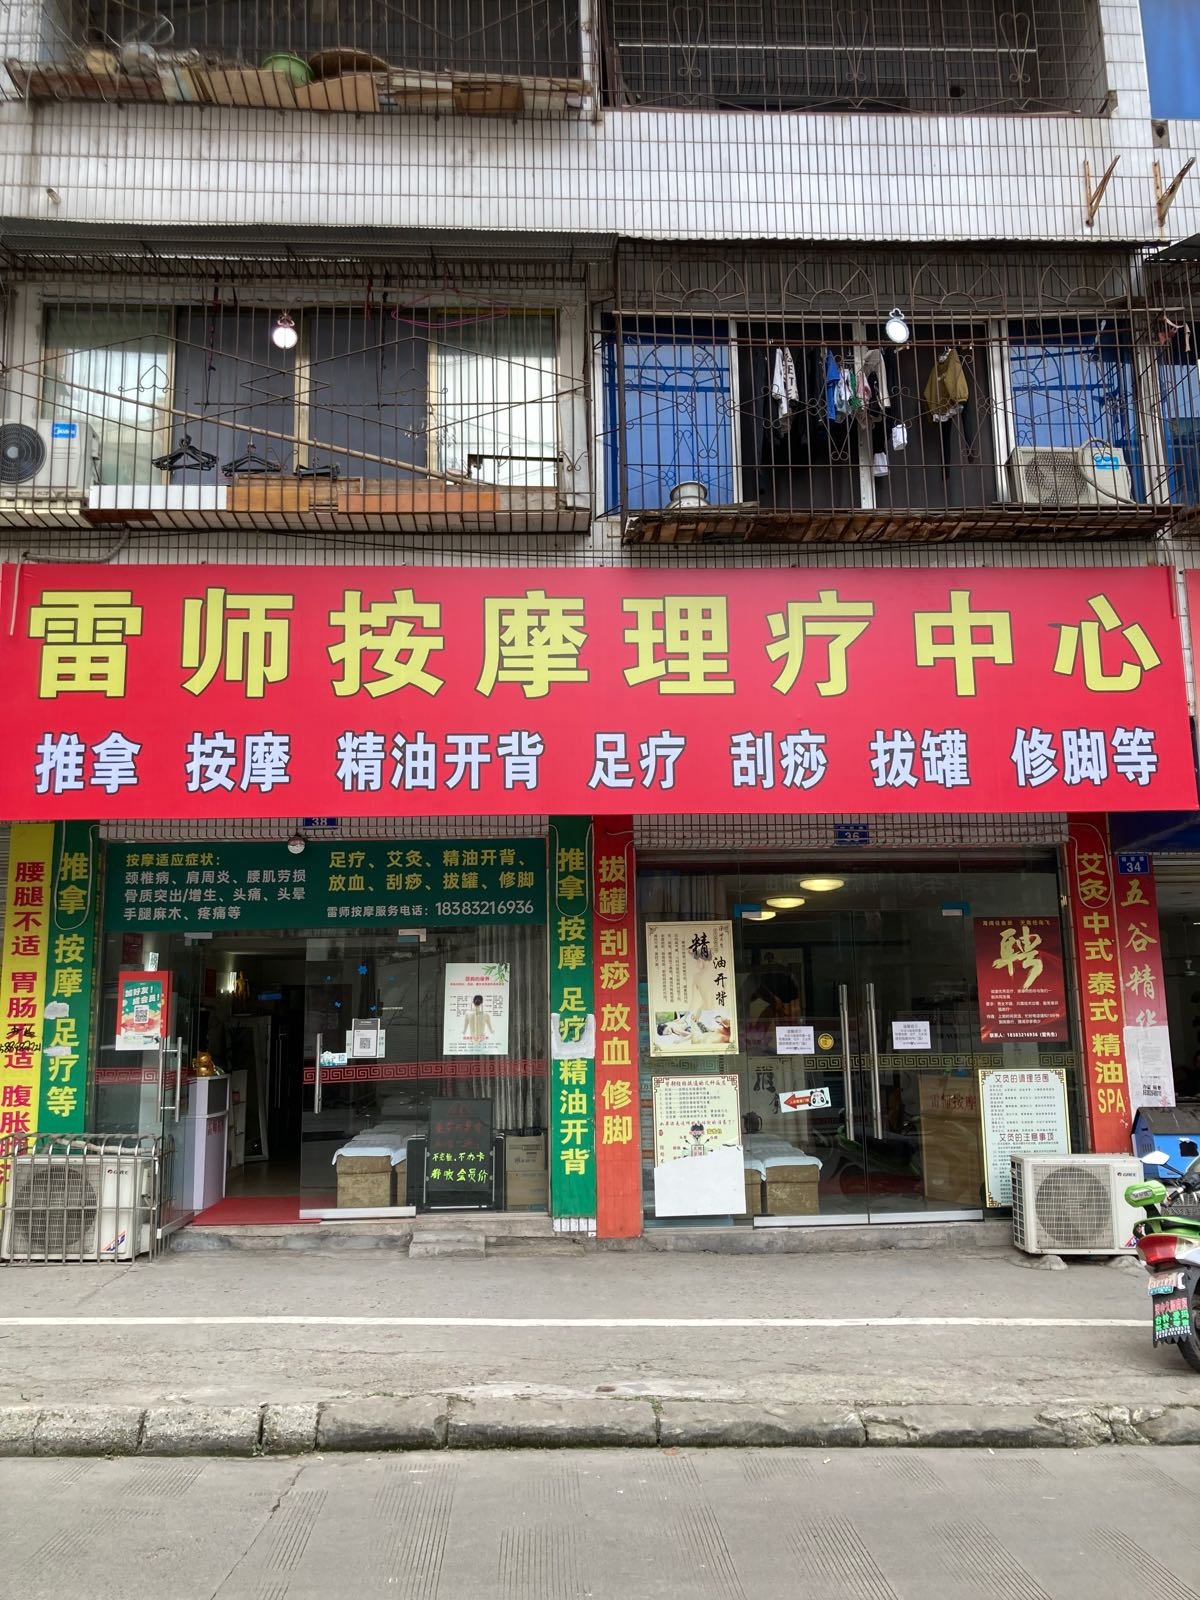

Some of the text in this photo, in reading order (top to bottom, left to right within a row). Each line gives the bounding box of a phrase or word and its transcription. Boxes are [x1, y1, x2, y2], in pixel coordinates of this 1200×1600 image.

[28, 586, 1162, 700] 雷师按摩理疗中心
[35, 726, 1159, 794] 推拿 按摩 精油开背 足疗 刮痧 拔罐 修脚等
[312, 817, 328, 826] 38
[125, 869, 306, 885] 颈椎病、肩周炎、腰肌劳损
[126, 853, 220, 867] 按摩适应症状：
[328, 871, 534, 892] 放血、刮痧、拔罐、修脚
[329, 848, 526, 868] 足疗、艾灸、精油开背、
[1126, 861, 1142, 873] 34
[12, 861, 45, 956] 腰腿不适
[123, 905, 241, 921] 手腿麻木、疼痛等
[124, 887, 305, 904] 骨质突出/增生、头痛、头晕
[47, 852, 89, 1118] 推拿 按摩 足疗等
[689, 932, 728, 1007] 精 油开背
[992, 925, 1044, 990] 聘
[1078, 852, 1126, 1114] 艾灸 中式 泰式 精油SPA
[557, 847, 590, 1176] 推拿 按摩 足疗 精油开背
[598, 855, 633, 1146] 拔罐 刮痧 放血 修脚
